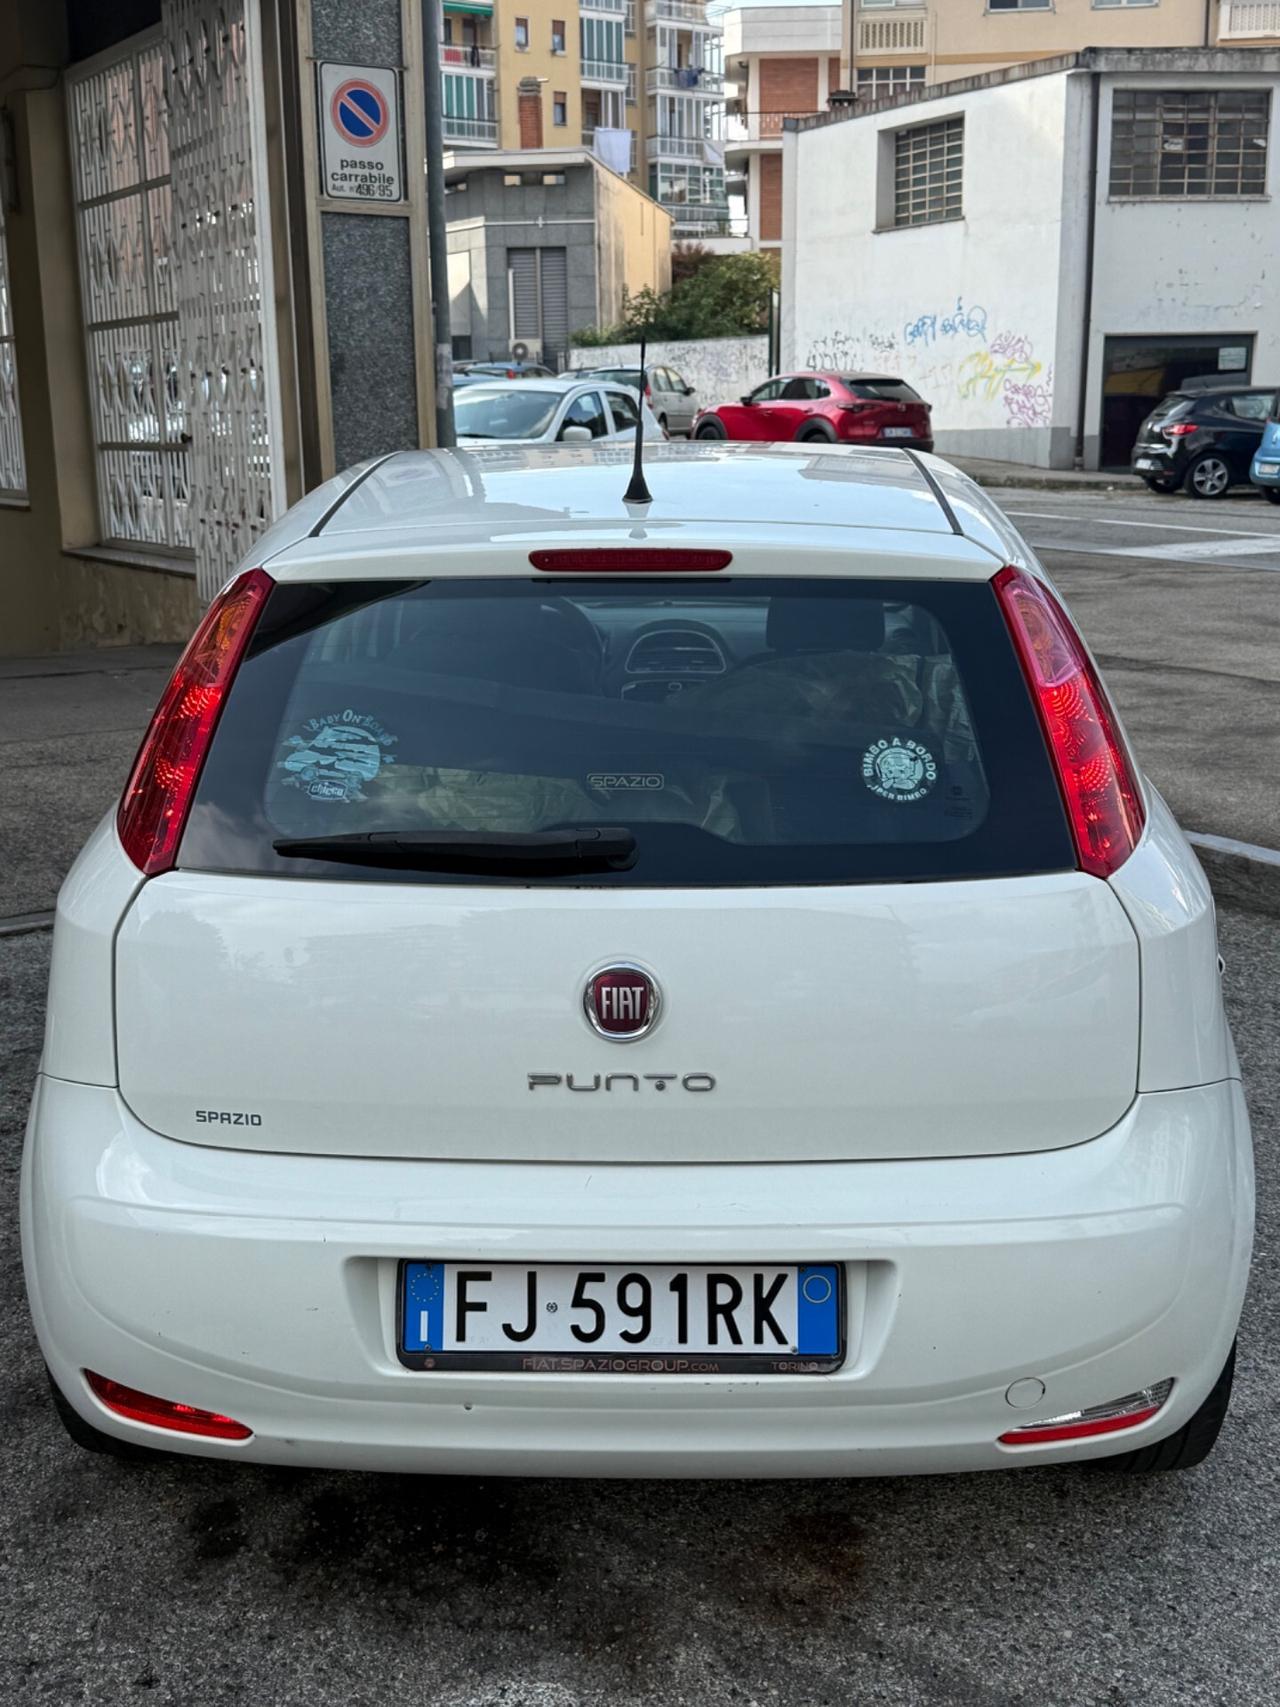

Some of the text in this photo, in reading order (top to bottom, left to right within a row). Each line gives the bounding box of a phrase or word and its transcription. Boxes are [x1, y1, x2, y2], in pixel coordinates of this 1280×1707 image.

[340, 159, 384, 171] passo
[331, 172, 394, 185] carrabile
[863, 737, 937, 780] BIMBO A BORDO
[590, 776, 661, 788] SPAZIO
[601, 986, 644, 1020] FIAT
[528, 1072, 716, 1093] PUNTO
[195, 1110, 262, 1127] SPAZIO
[456, 1271, 789, 1344] FJ 591RK
